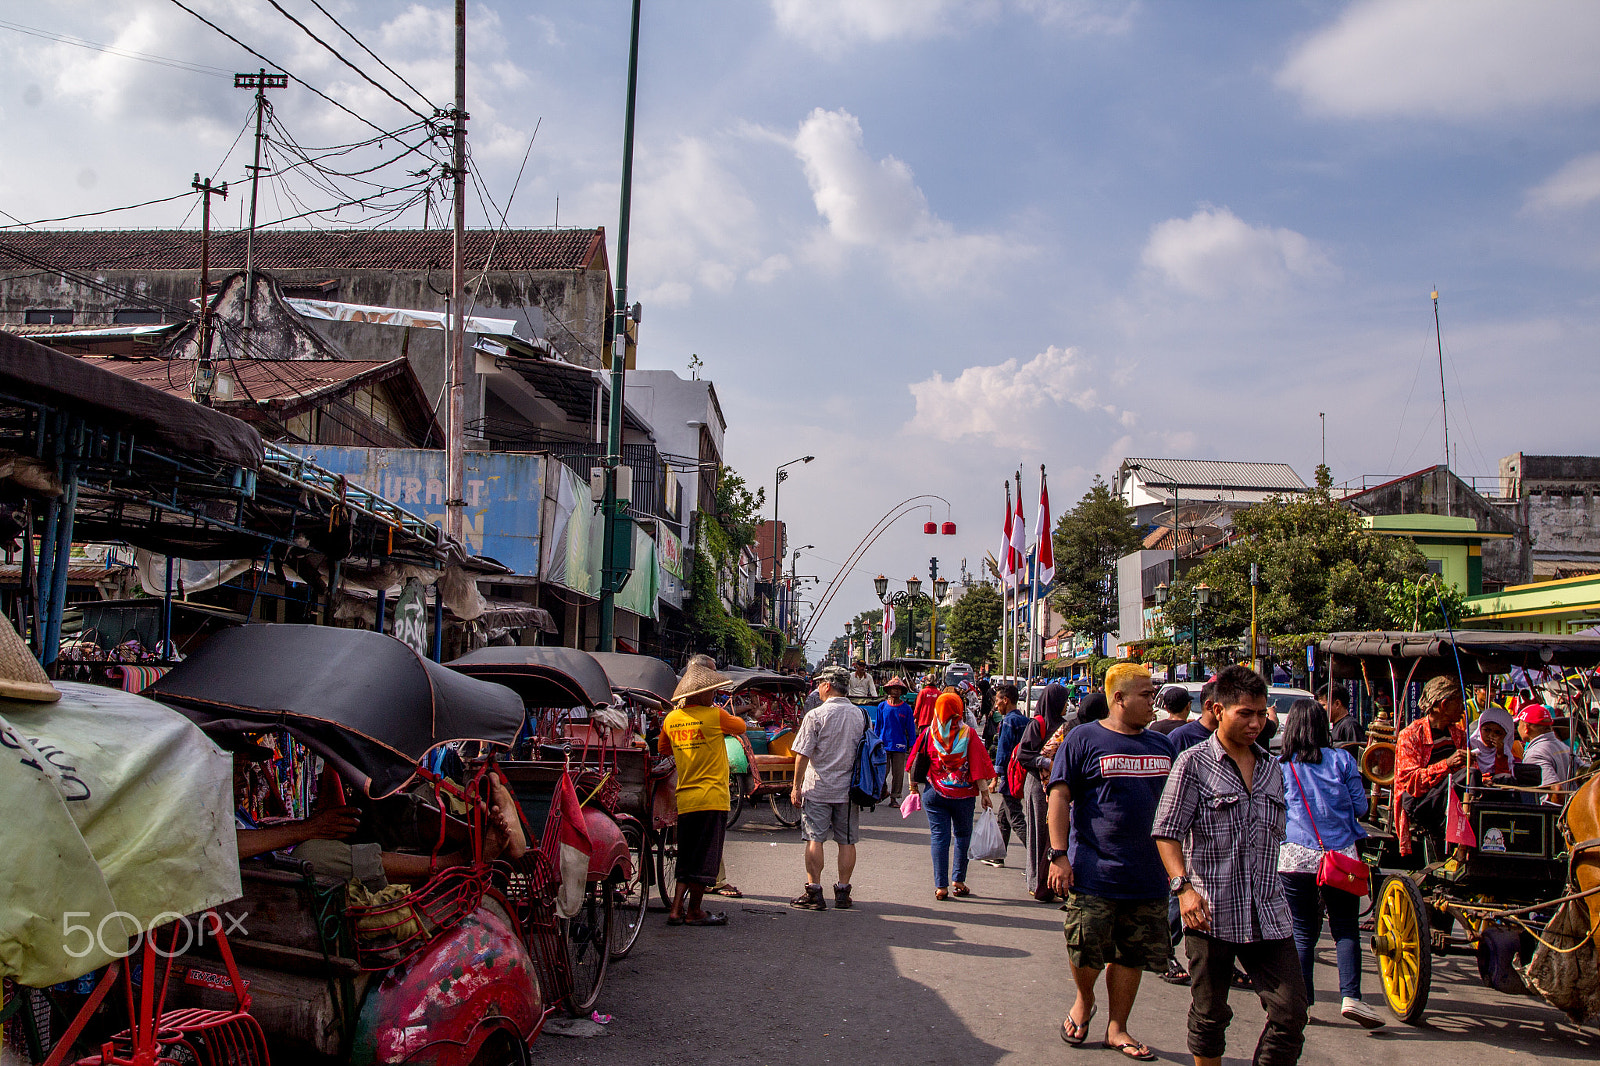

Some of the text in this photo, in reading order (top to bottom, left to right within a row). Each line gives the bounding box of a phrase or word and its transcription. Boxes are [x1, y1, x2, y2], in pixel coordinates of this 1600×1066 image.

[1519, 711, 1528, 721] 21
[669, 728, 705, 742] VISTA
[1103, 757, 1141, 770] WISATA
